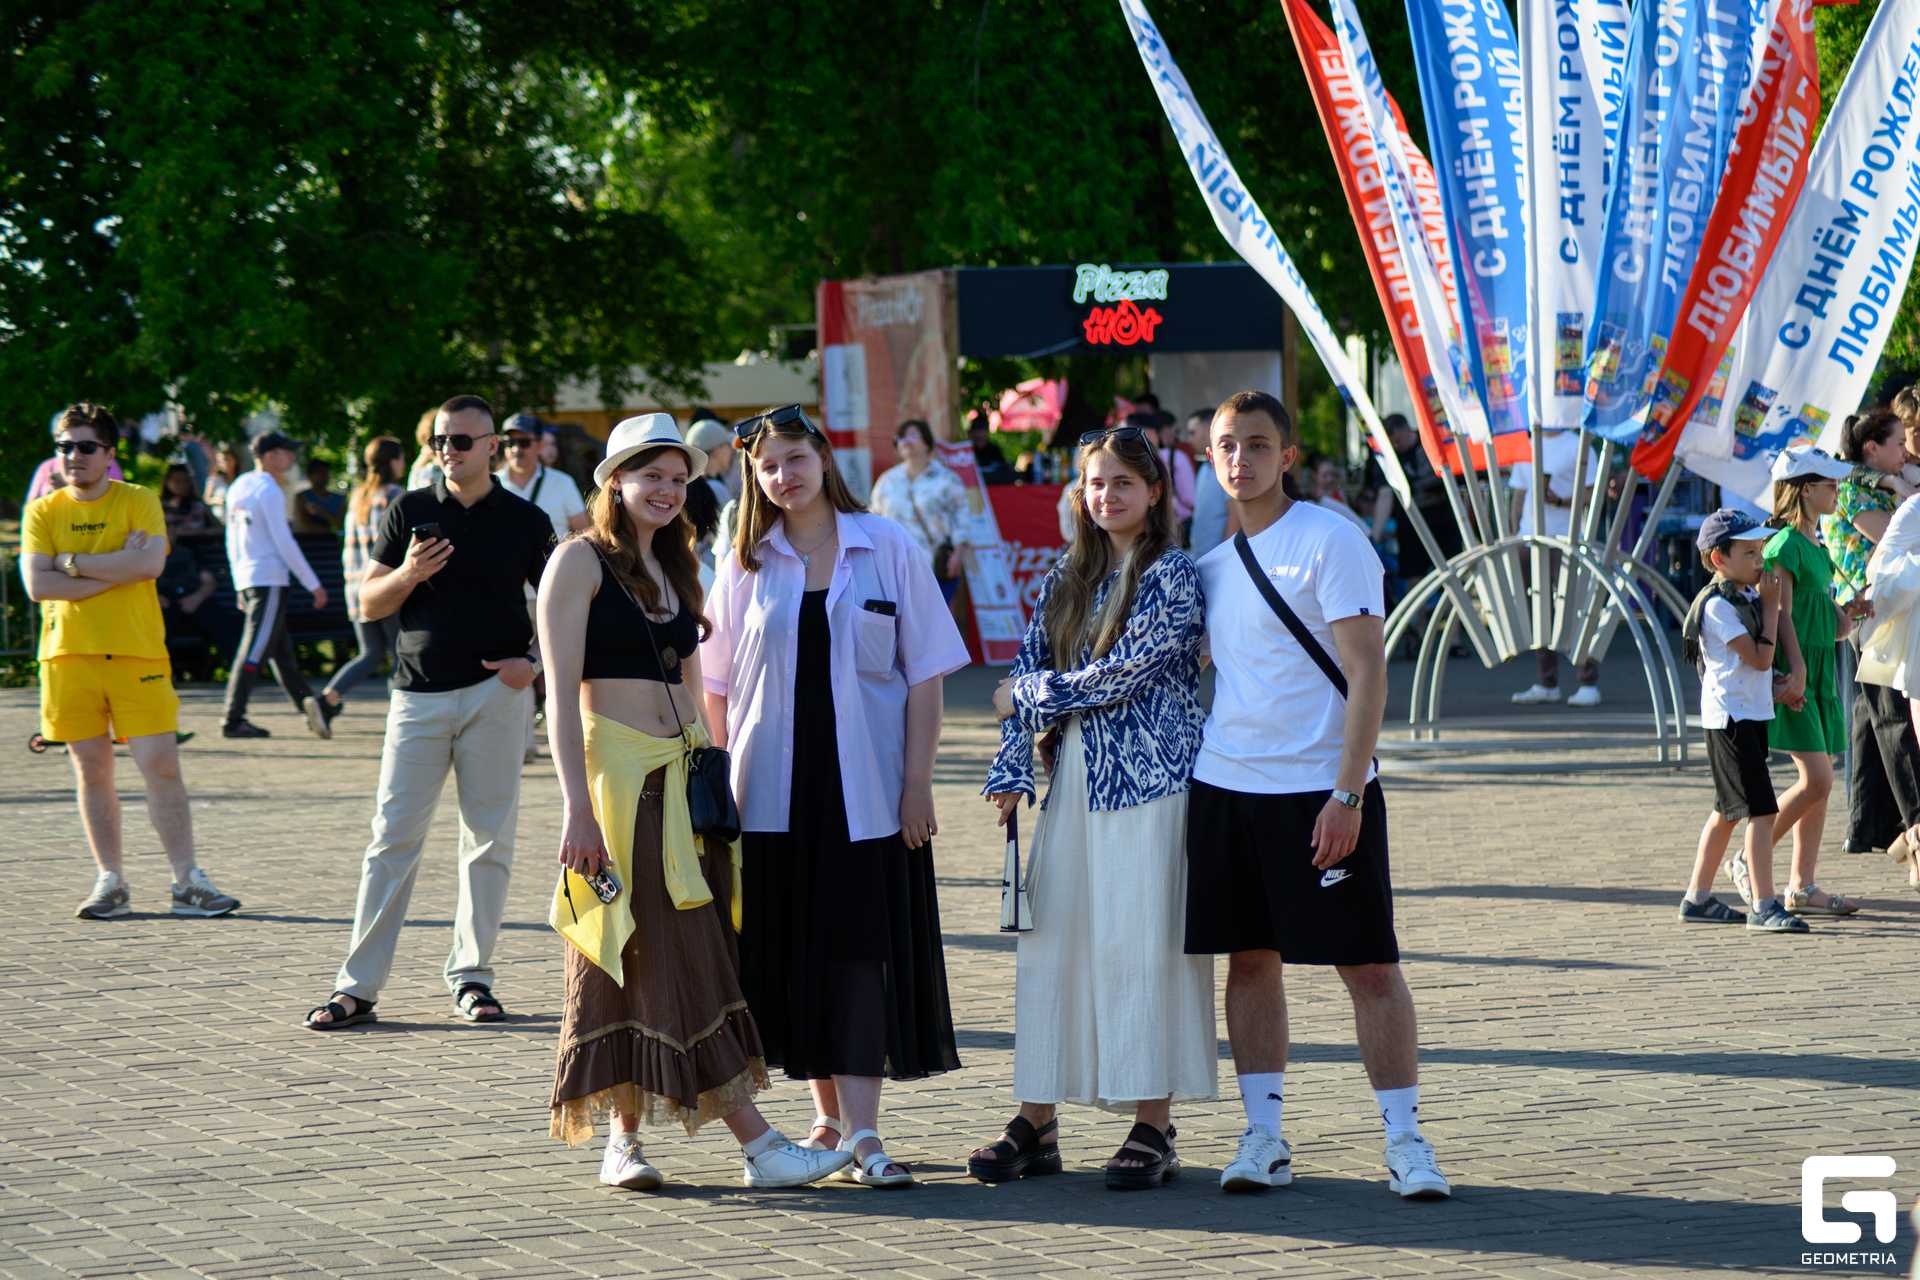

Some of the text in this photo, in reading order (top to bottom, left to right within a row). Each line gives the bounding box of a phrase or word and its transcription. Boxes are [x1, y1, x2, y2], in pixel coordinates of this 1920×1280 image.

[1317, 49, 1383, 194] РОЖДЕ
[1454, 118, 1509, 239] ДНЁМ
[1552, 96, 1586, 226] ДНЁМ
[1622, 105, 1666, 245] ДНЁМ
[1662, 32, 1733, 293] ЛЮБИМЫЙ
[1073, 263, 1170, 304] Pizza
[1473, 248, 1507, 277] С
[1559, 236, 1579, 264] С
[1613, 251, 1644, 283] С
[1687, 106, 1808, 343] ЛЮБИМЫЙ
[1778, 321, 1811, 350] С
[1795, 198, 1870, 320] ДНЁМ
[1325, 869, 1347, 879] NIKE
